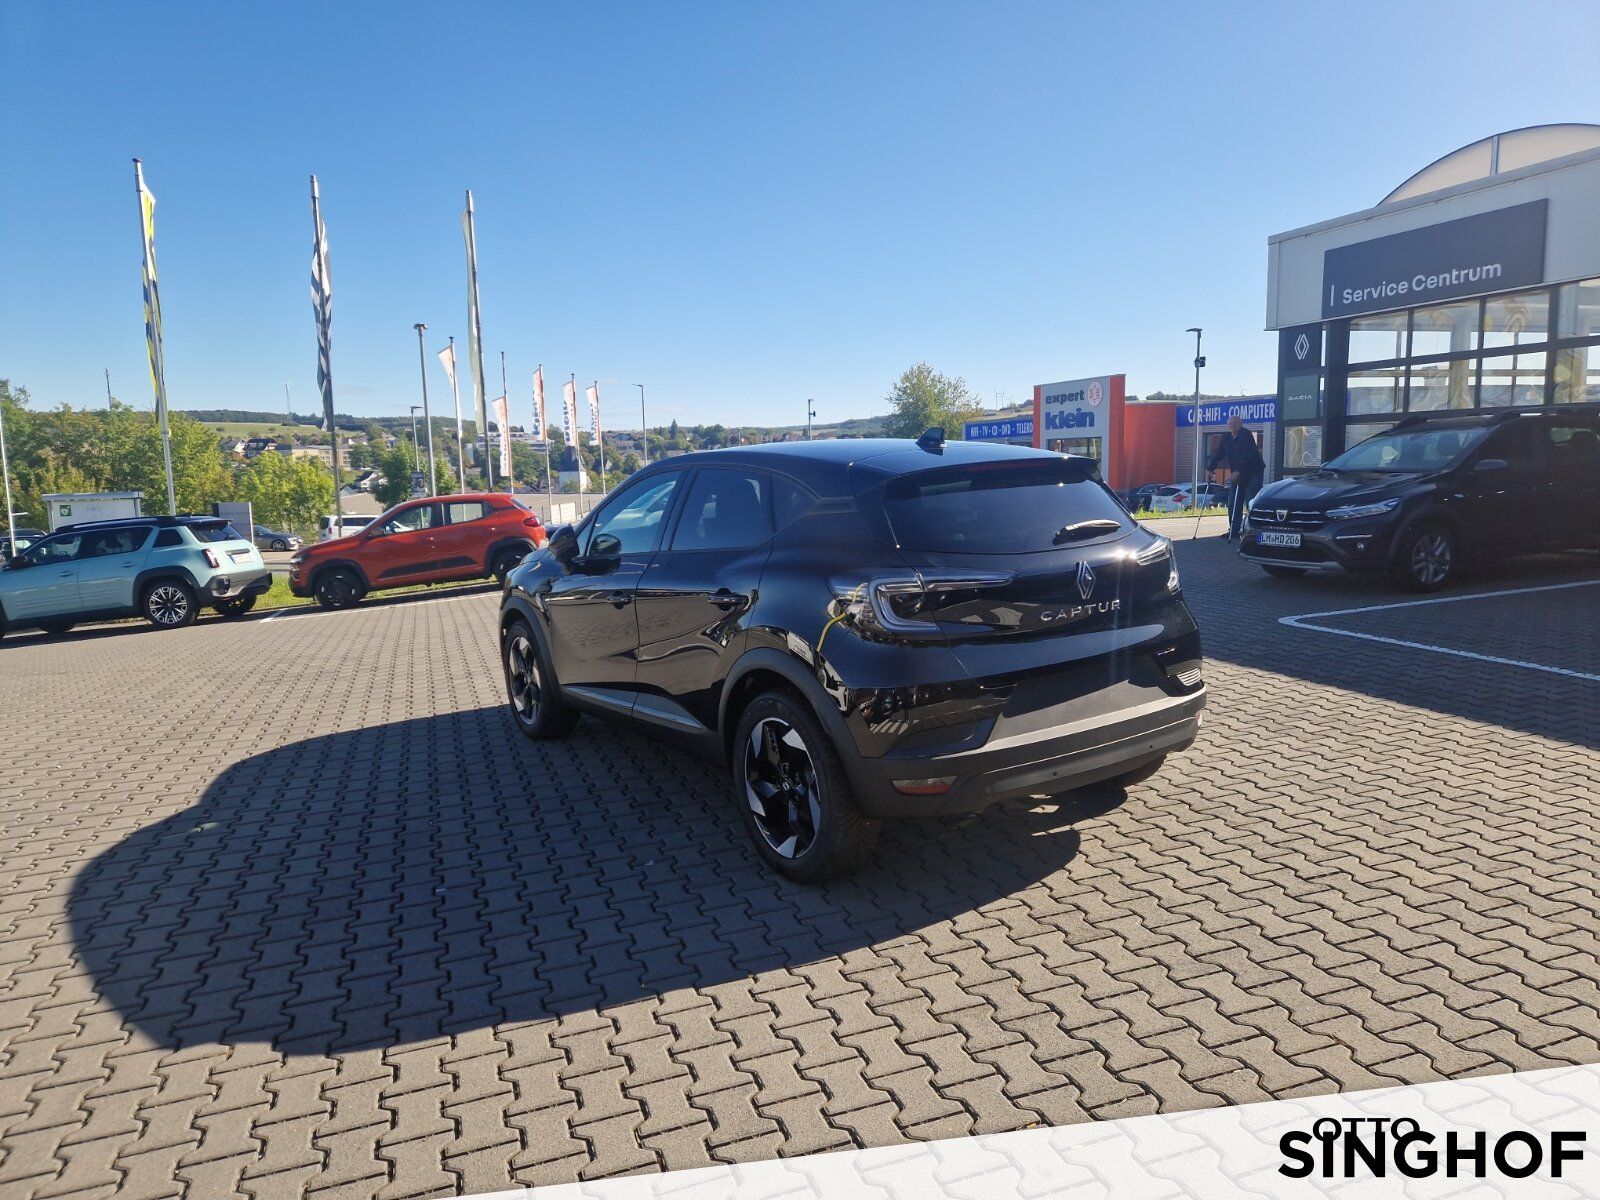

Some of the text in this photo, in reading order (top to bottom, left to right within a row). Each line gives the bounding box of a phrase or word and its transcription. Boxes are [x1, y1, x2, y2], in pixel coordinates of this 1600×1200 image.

[1342, 263, 1501, 304] Service Centrum
[1045, 389, 1085, 405] expert
[1044, 407, 1095, 430] klein
[1228, 403, 1275, 420] COMPUTER
[1040, 599, 1120, 621] CAPTUR
